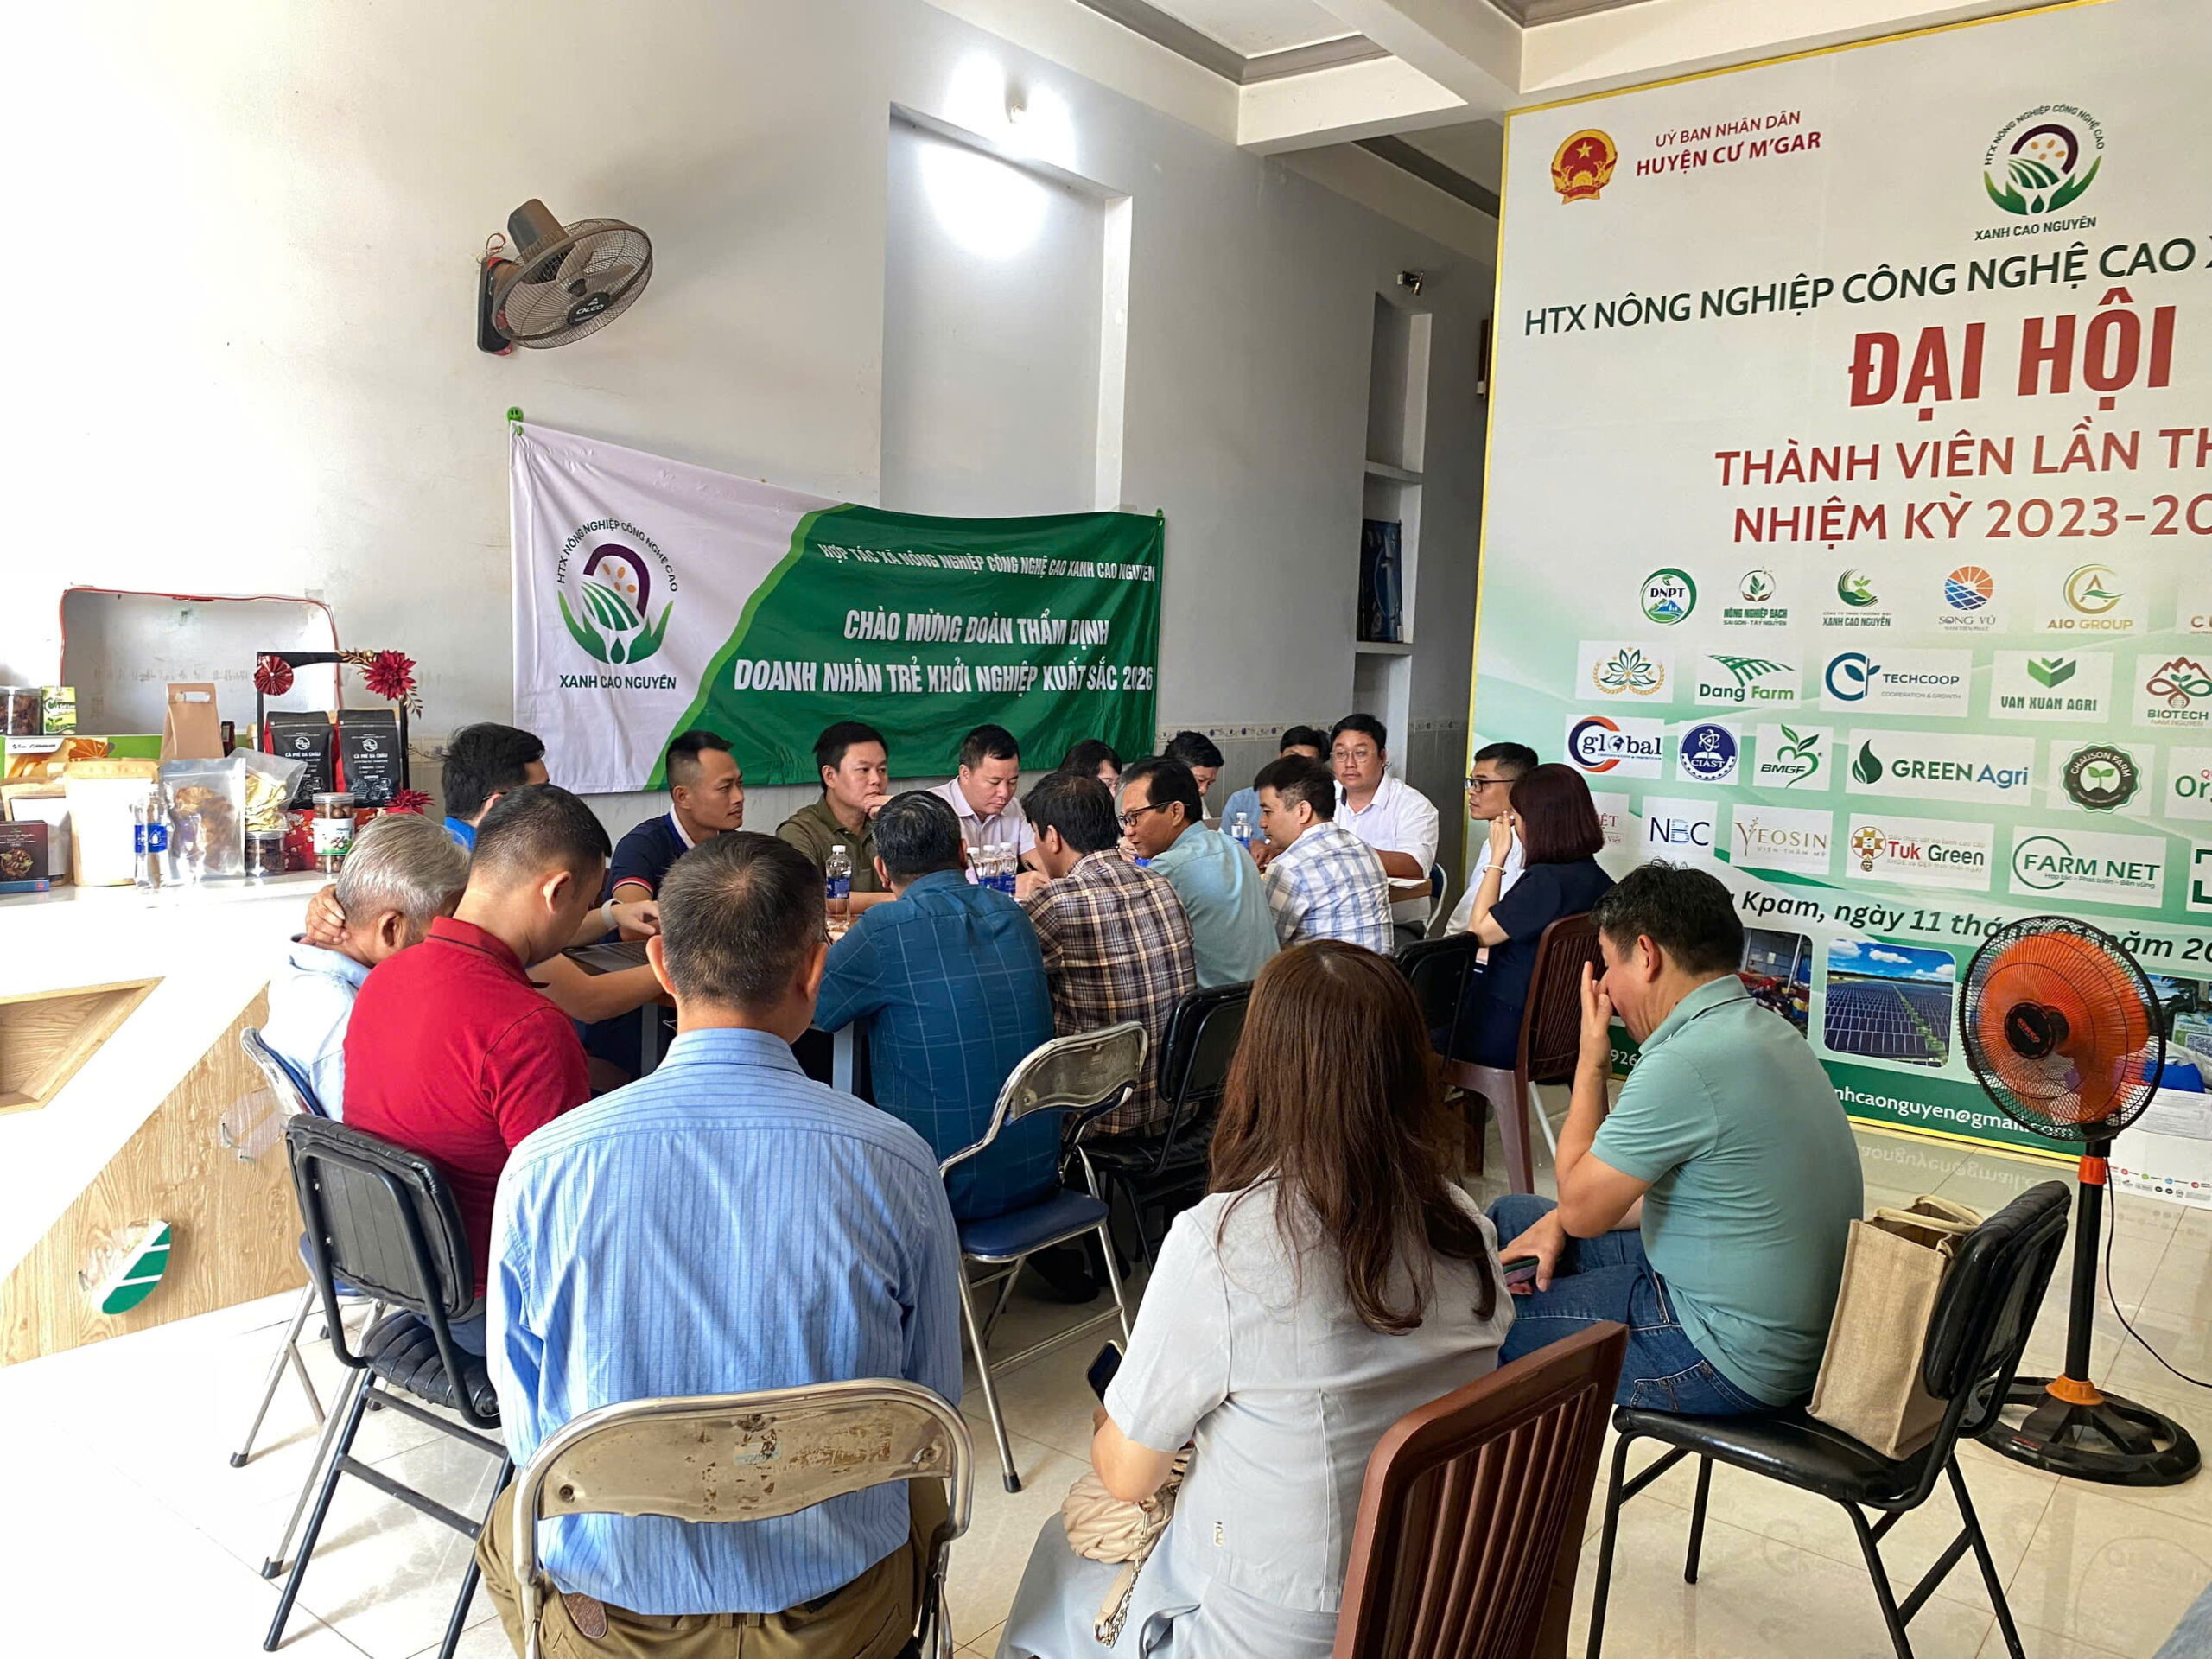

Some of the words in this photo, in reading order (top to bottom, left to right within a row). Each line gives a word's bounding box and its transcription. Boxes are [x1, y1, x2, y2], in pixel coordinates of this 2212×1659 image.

[1681, 125, 1712, 143] BAN
[1715, 118, 1761, 137] NHÂN
[1765, 111, 1802, 130] DÂN
[1985, 145, 1998, 166] HTX
[1993, 121, 2017, 144] NÔNG
[2052, 104, 2078, 116] CÔNG
[2093, 130, 2105, 150] CAO
[1637, 149, 1707, 176] HUYỆN
[1713, 141, 1745, 164] CƯ
[1974, 226, 2010, 241] XANH
[2013, 223, 2039, 237] CAO
[2043, 216, 2096, 233] NGUYÊN
[1524, 304, 1586, 336] HTX
[1594, 292, 1692, 329] NÔNG
[1700, 273, 1834, 319] NGHIỆP
[1842, 263, 1956, 304] CÔNG
[1967, 240, 2088, 291] NGHỆ
[2098, 237, 2196, 278] CAO
[1848, 321, 1986, 422] ĐẠI
[2018, 287, 2177, 411] HỘI
[1714, 438, 1880, 486] THÀNH
[1896, 429, 2015, 479] VIÊN
[2032, 416, 2139, 474] LẦN
[1733, 495, 1887, 550] NHIỆM
[1904, 491, 1974, 539] KỲ
[557, 556, 568, 584] HTX
[563, 529, 585, 556] NÔNG
[582, 518, 620, 534] NGHIỆP
[620, 522, 645, 541] CÔNG
[645, 537, 669, 564] NGHỆ
[665, 565, 678, 592] CAO
[817, 544, 849, 563] HỢP
[849, 546, 879, 563] TÁC
[876, 550, 902, 565] XÃ
[898, 550, 940, 569] NÔNG
[937, 553, 985, 574] NGHIỆP
[986, 553, 1018, 573] CÔNG
[1020, 555, 1047, 578] NGHỆ
[1049, 560, 1067, 576] CAO
[1066, 560, 1095, 577] XANH
[1097, 563, 1116, 579] CAO
[1650, 588, 1685, 598] DNPT
[843, 605, 901, 641] CHÀO
[905, 608, 963, 643] MỪNG
[964, 612, 1014, 643] ĐOÀN
[1016, 608, 1067, 645] THẨM
[1068, 620, 1109, 650] ĐỊNH
[1823, 617, 1843, 626] XANH
[1845, 617, 1859, 626] CAO
[2048, 619, 2074, 629] AIO
[2079, 619, 2133, 630] GROUP
[560, 674, 598, 689] XANH
[600, 676, 622, 689] CAO
[626, 674, 676, 690] NGUYÊN
[734, 658, 817, 691] DOANH
[823, 657, 883, 692] NHÂN
[886, 655, 923, 693] TRẺ
[927, 656, 971, 693] KHỞI
[975, 660, 1039, 697] NGHIỆP
[1042, 657, 1086, 691] XUẤT
[1087, 656, 1118, 691] SẮC
[1123, 665, 1154, 690] 2026
[1883, 674, 1960, 684] TECHCOOP
[1700, 684, 1745, 702] Dang
[1751, 685, 1794, 700] Farm
[2029, 696, 2062, 709] XUAN
[2067, 698, 2097, 711] AGRI
[2147, 709, 2209, 721] BIOTECH
[1691, 759, 1725, 768] CIAST
[1761, 764, 1806, 774] BMGF
[1892, 760, 1973, 781] GREEN
[1977, 764, 2029, 789] Agri
[2111, 755, 2132, 778] FARM
[1650, 817, 1710, 846] NBC
[1735, 817, 1827, 856] YEOSIN
[1888, 841, 1920, 860] Tuk
[1929, 844, 1984, 866] Green
[2024, 854, 2098, 876] FARM
[2106, 861, 2161, 881] NET
[1741, 890, 1825, 923] Kpam,
[1834, 904, 1904, 932] ngày
[1910, 909, 1941, 931] 11
